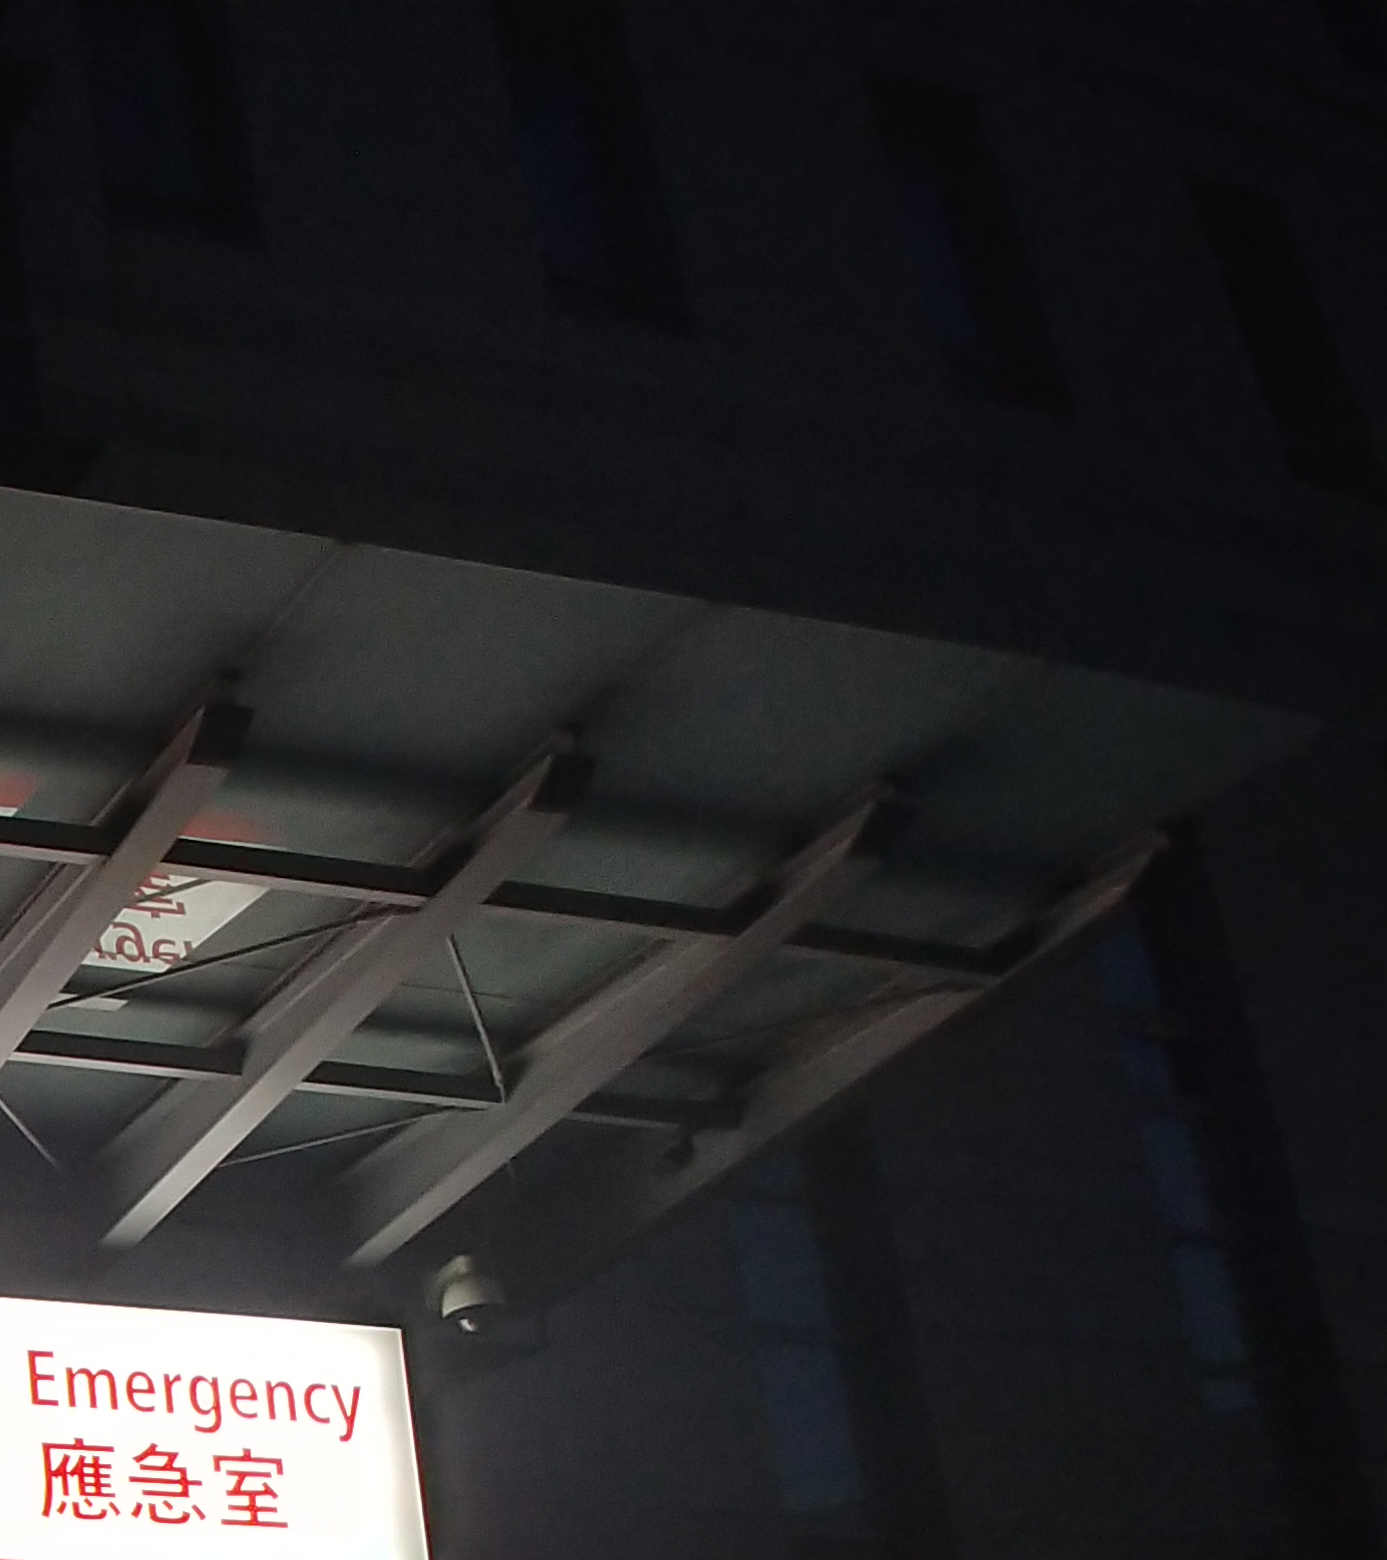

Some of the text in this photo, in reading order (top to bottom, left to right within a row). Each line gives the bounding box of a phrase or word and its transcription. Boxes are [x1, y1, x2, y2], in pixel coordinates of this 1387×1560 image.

[27, 1349, 361, 1442] Emergency
[40, 1437, 290, 1529] 應急室
